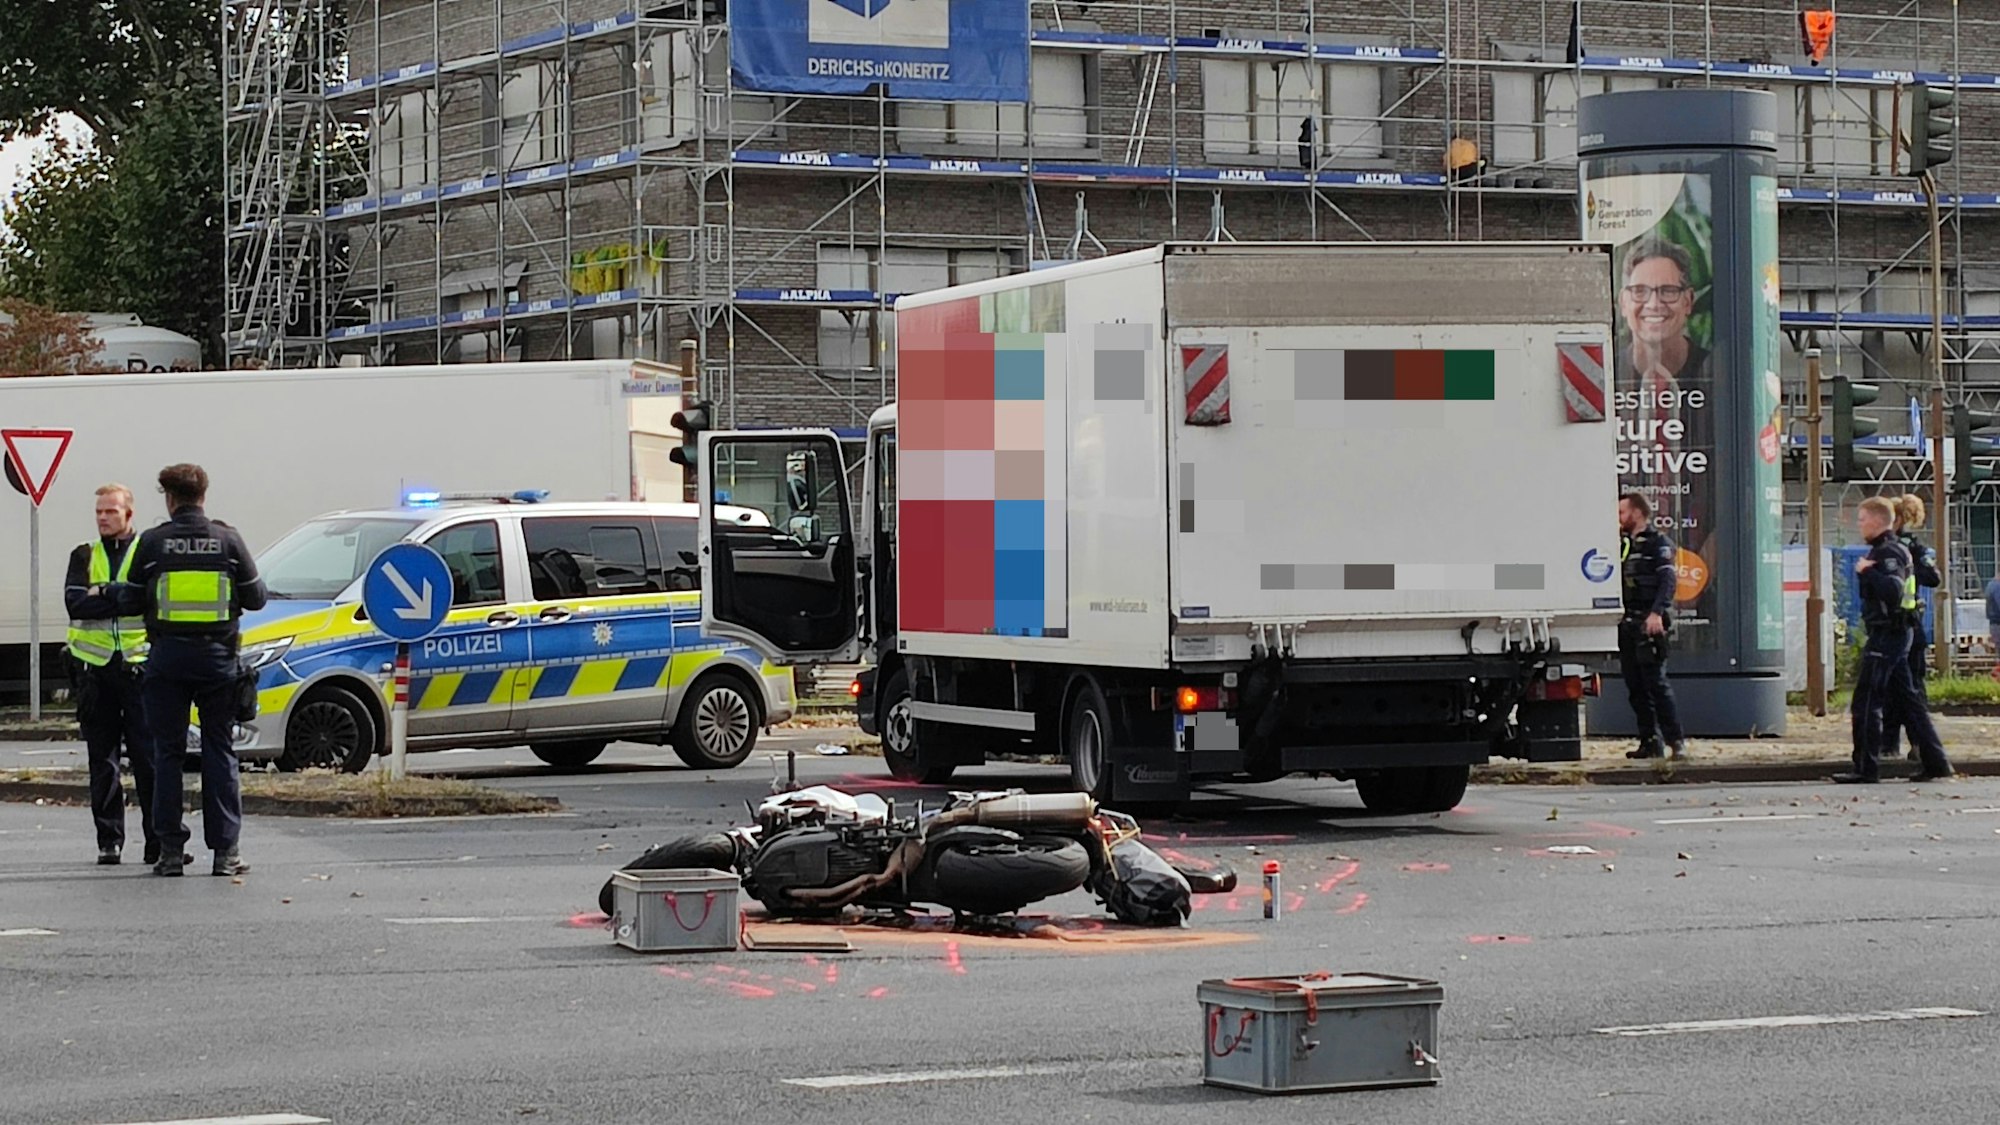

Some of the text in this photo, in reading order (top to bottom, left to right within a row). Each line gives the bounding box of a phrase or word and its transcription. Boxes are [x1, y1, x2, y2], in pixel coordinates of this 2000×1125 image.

[791, 153, 831, 166] ALPHA
[942, 160, 980, 172] ALPHA
[1233, 170, 1265, 181] ALPHA
[1370, 174, 1402, 185] ALPHA
[1598, 199, 1613, 209] The
[1598, 209, 1653, 220] Generation
[1598, 219, 1626, 230] Forest
[791, 290, 831, 301] ALPHA
[164, 538, 222, 554] POLIZEI
[424, 633, 502, 659] POLIZEI
